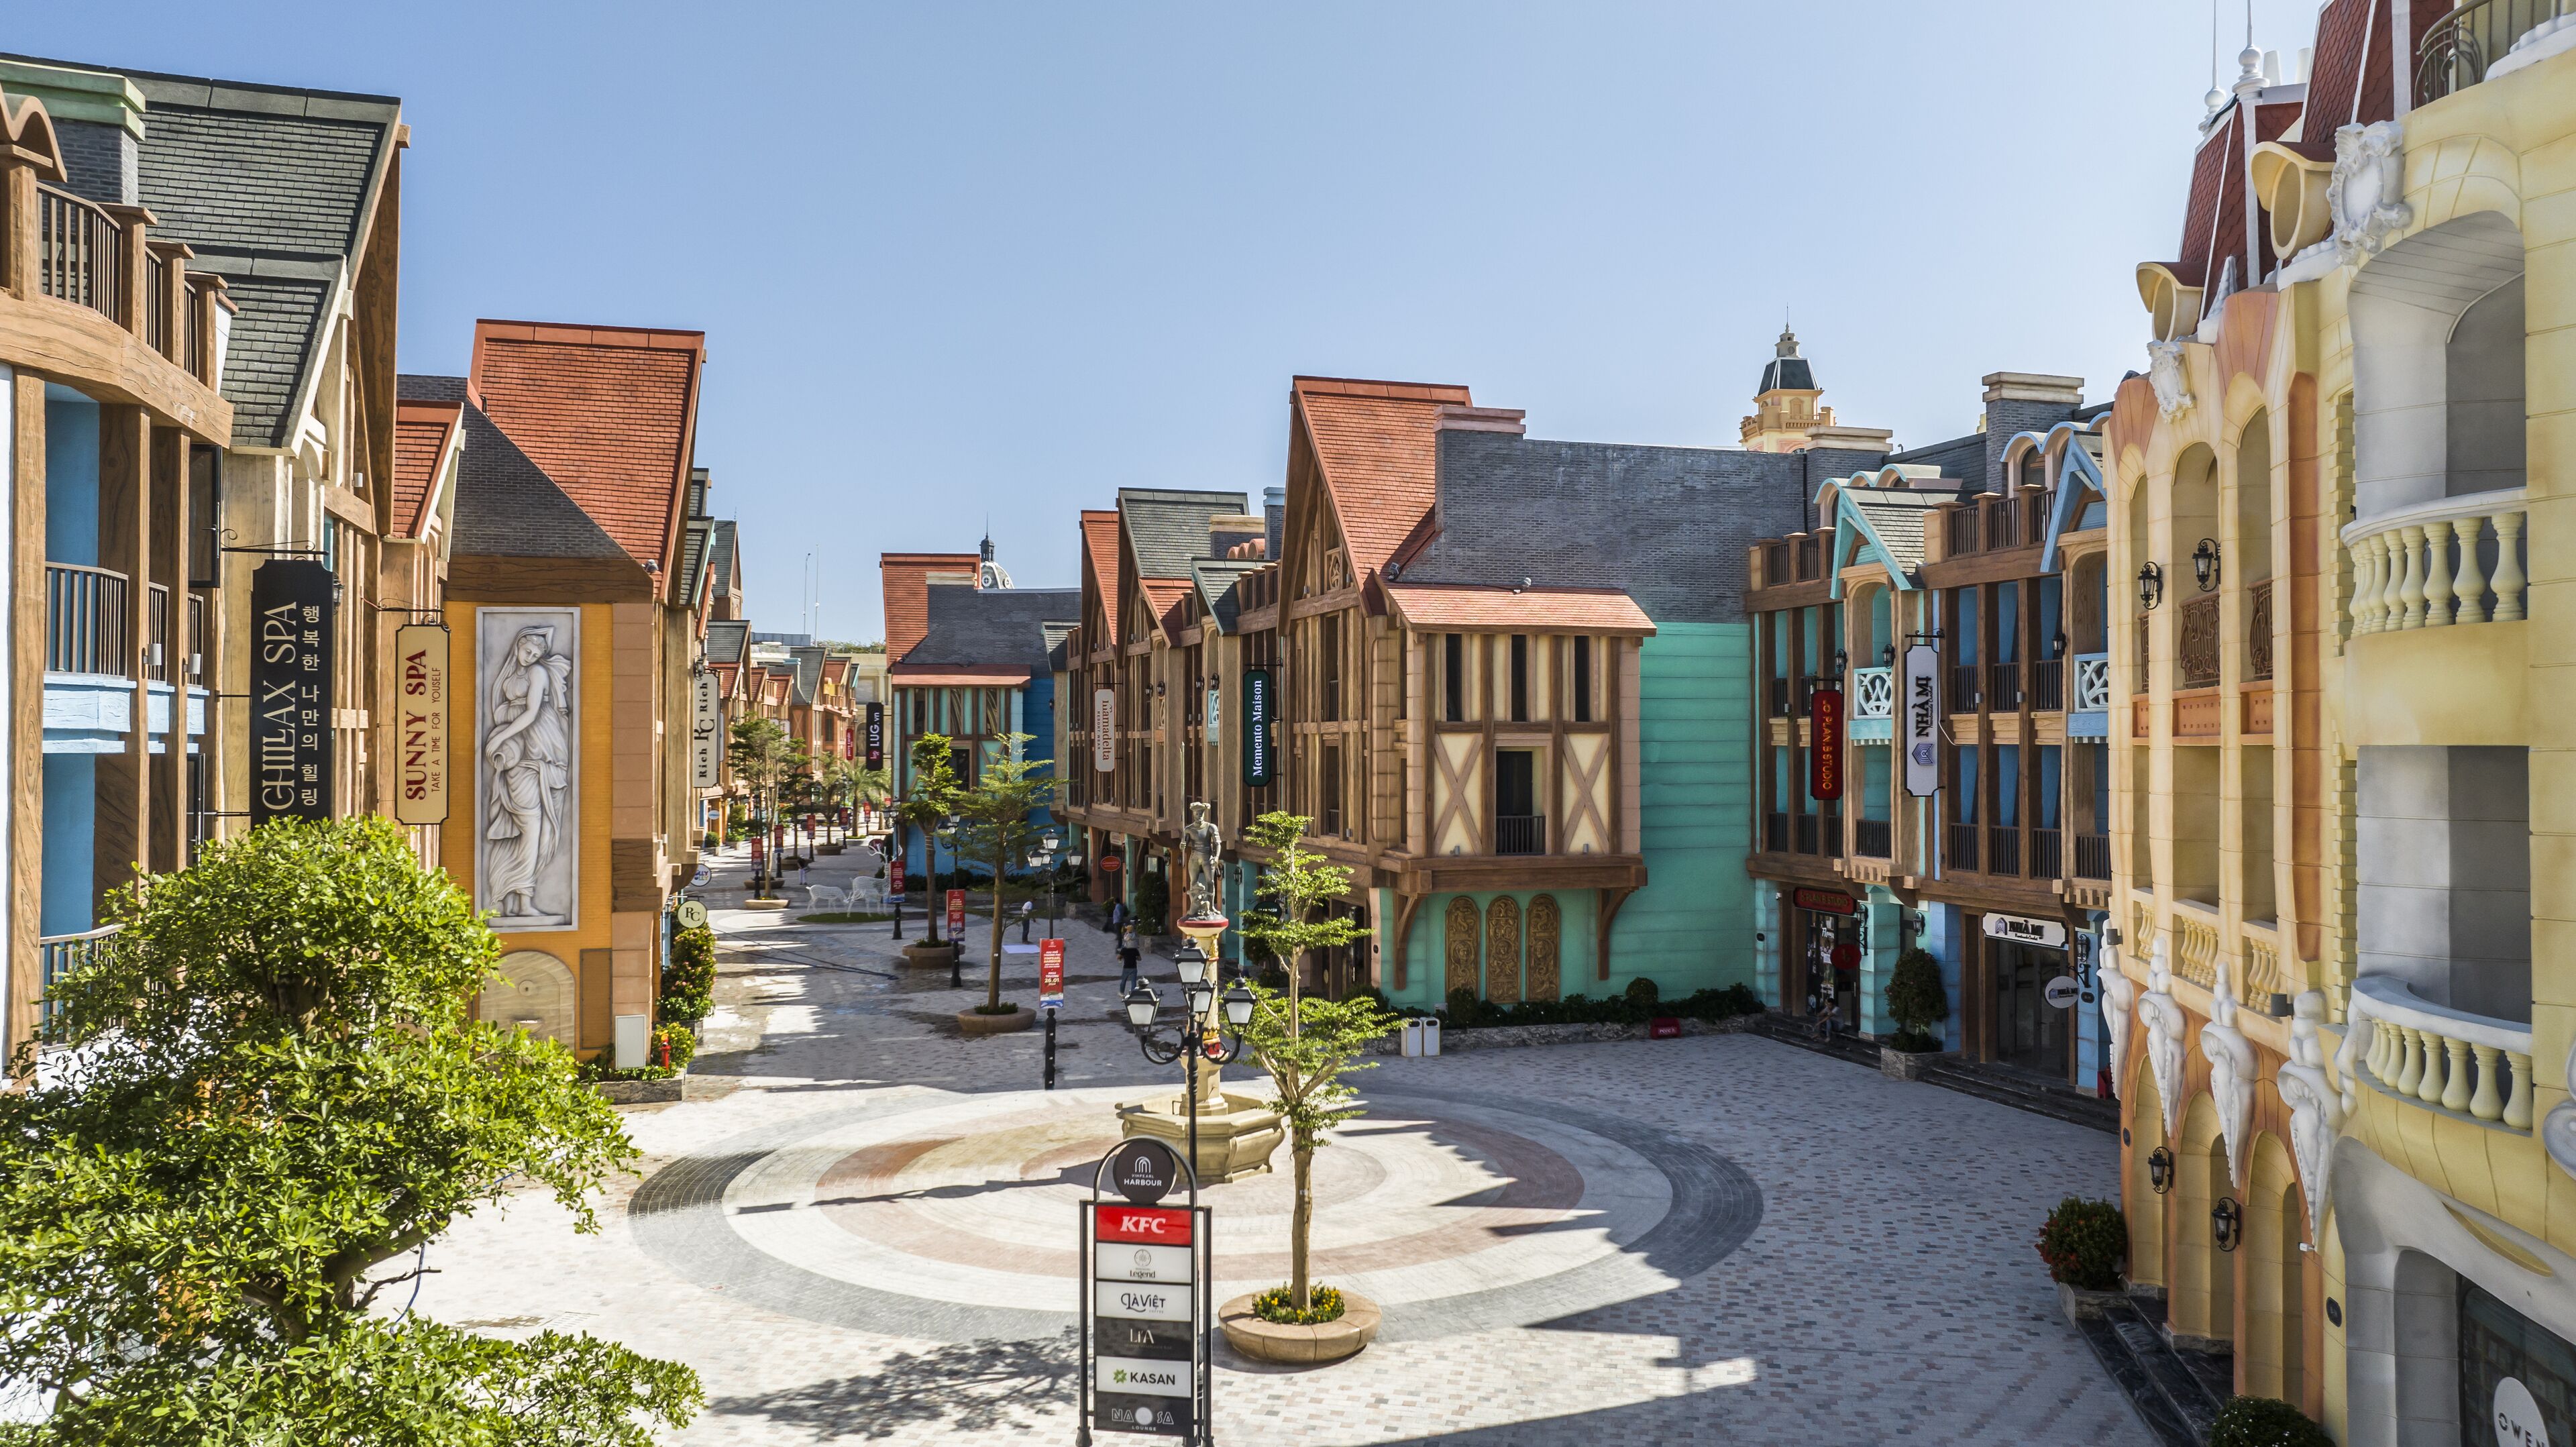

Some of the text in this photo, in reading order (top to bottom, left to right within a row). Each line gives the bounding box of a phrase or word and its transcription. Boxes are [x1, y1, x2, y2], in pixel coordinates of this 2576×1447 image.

[264, 602, 297, 663] SPA
[431, 667, 441, 703] YOUSELF
[699, 683, 708, 712] Rich
[301, 606, 320, 805] 행복한 나만의 힐링
[431, 712, 441, 729] FOR
[1912, 700, 1930, 737] NHÀ
[405, 649, 427, 800] SUNNY SPA
[869, 712, 880, 746] LUG.vn
[1102, 700, 1112, 760] mamadelta
[1252, 680, 1263, 777] Memento Maison
[431, 736, 440, 753] TIME
[699, 748, 707, 778] Rich
[1822, 754, 1833, 790] STUDIO
[431, 771, 440, 792] TAKE
[685, 907, 700, 921] RC
[1124, 1178, 1162, 1187] HARBOUR
[1120, 1216, 1166, 1234] KFC
[1130, 1270, 1156, 1279] Legend
[1130, 1372, 1175, 1385] KASAN
